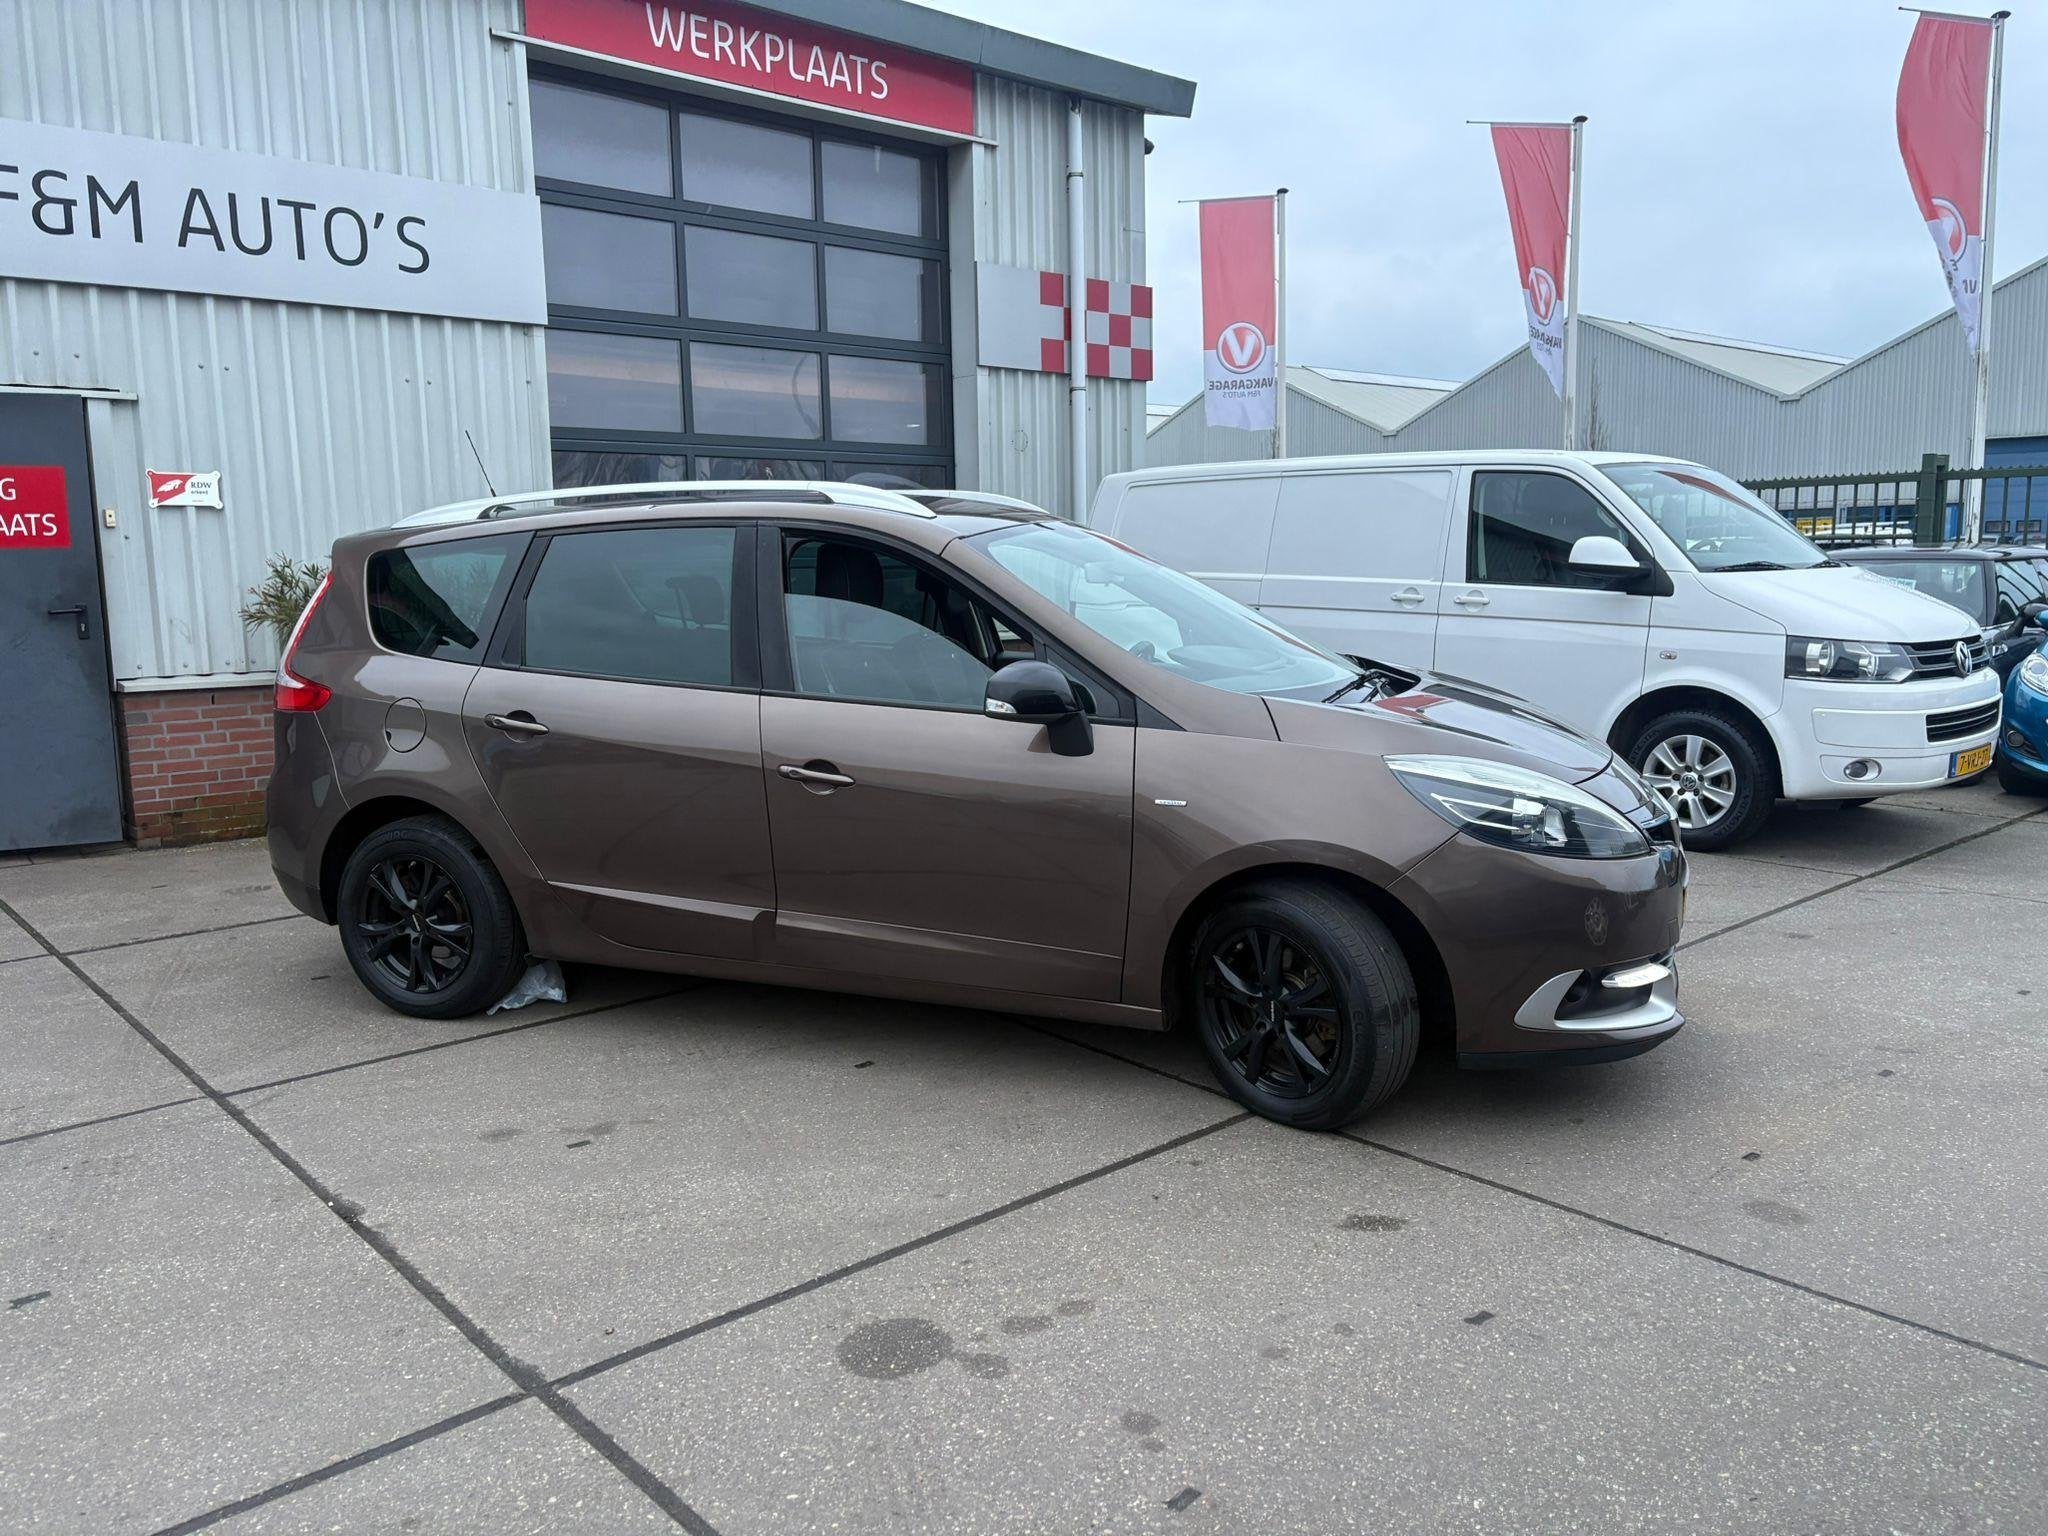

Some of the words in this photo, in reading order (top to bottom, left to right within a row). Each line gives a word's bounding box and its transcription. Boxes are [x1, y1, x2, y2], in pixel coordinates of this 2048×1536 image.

[646, 2, 889, 101] WERKPLAATS
[177, 187, 431, 275] AUTO'S
[190, 481, 212, 489] RDW
